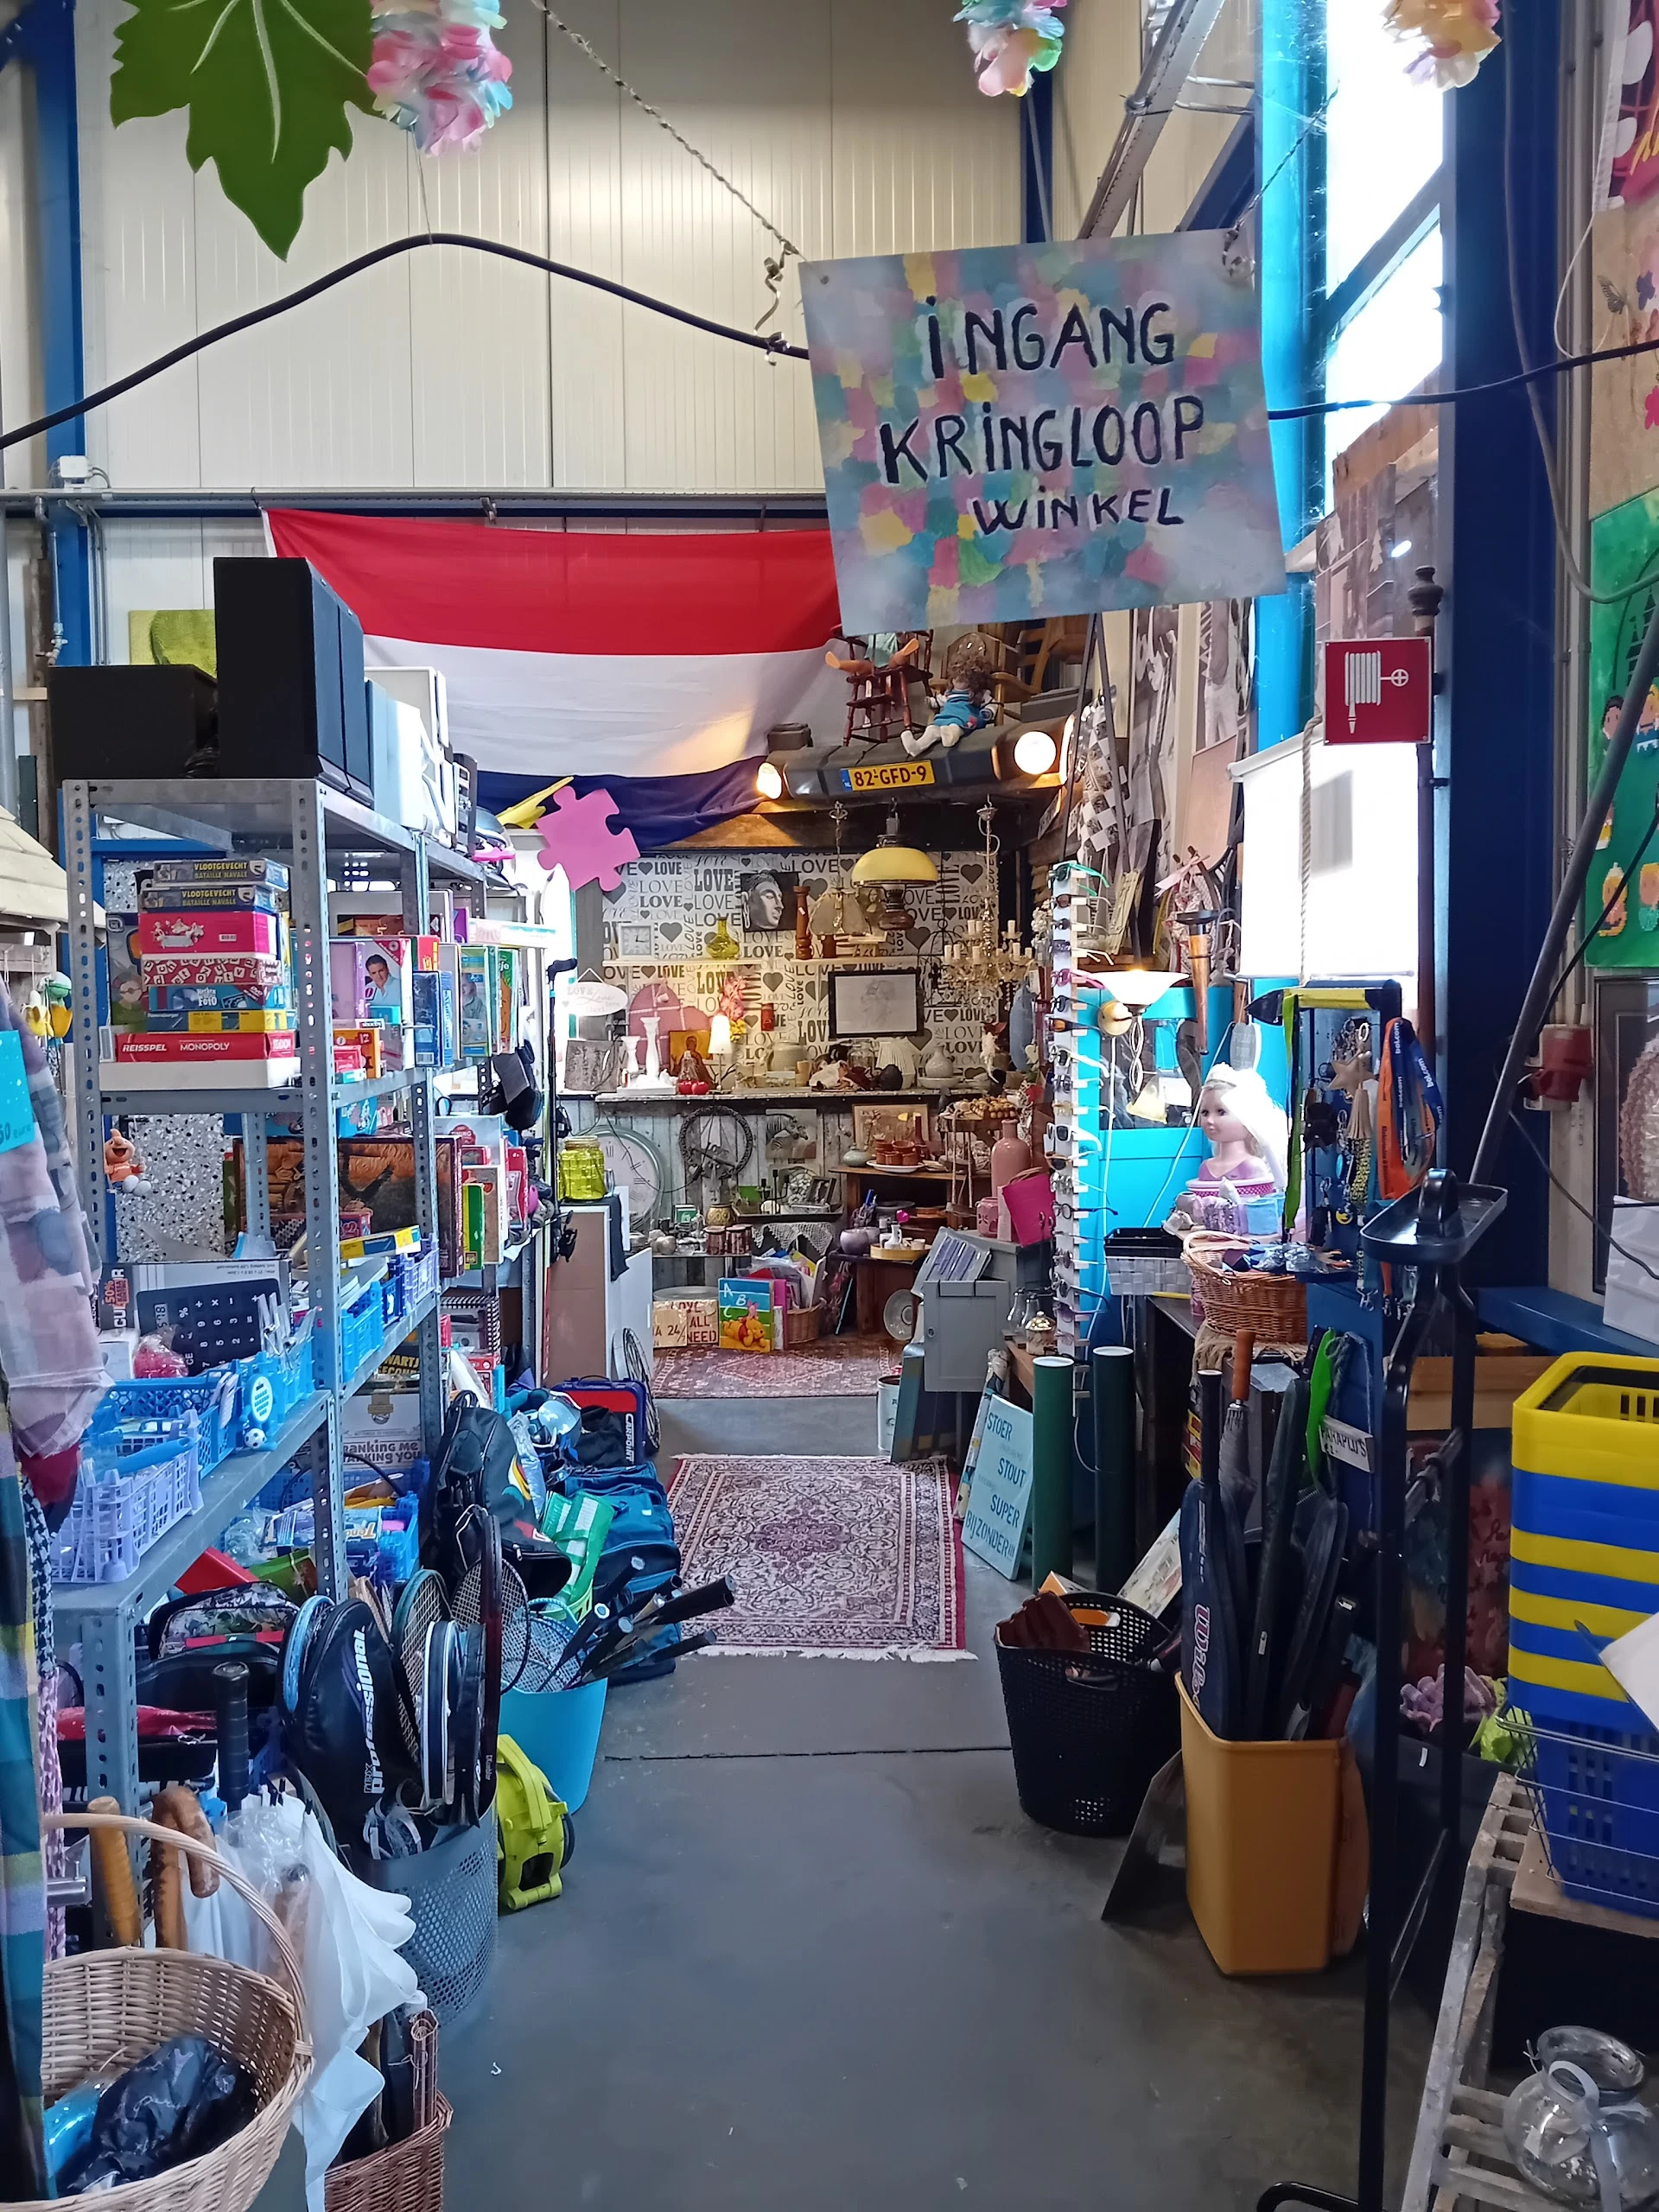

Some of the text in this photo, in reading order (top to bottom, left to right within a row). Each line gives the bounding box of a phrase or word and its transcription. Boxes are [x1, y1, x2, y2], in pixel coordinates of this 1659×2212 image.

[194, 862, 248, 871] VLOOTGEVECHT
[655, 861, 683, 875] LOVE
[791, 859, 838, 874] LOVE
[639, 880, 683, 893] LOVE
[694, 868, 734, 892] LOVE
[181, 889, 237, 899] VLOOTGEVECHT
[639, 895, 683, 908] LOVE
[695, 894, 734, 910] LOVE
[744, 946, 784, 958] LOVE
[122, 1042, 230, 1052] REISSPEL MONOPOLY
[1418, 1058, 1434, 1088] bol.com
[723, 1283, 734, 1298] A
[736, 1294, 747, 1306] B
[724, 1306, 733, 1319] C
[690, 1315, 710, 1328] ALL
[987, 1412, 1013, 1441] STOER
[998, 1457, 1027, 1488] STOUT
[990, 1494, 1020, 1529] SUPER
[1192, 1604, 1210, 1712] Wilso
[353, 1628, 385, 1795] professional
